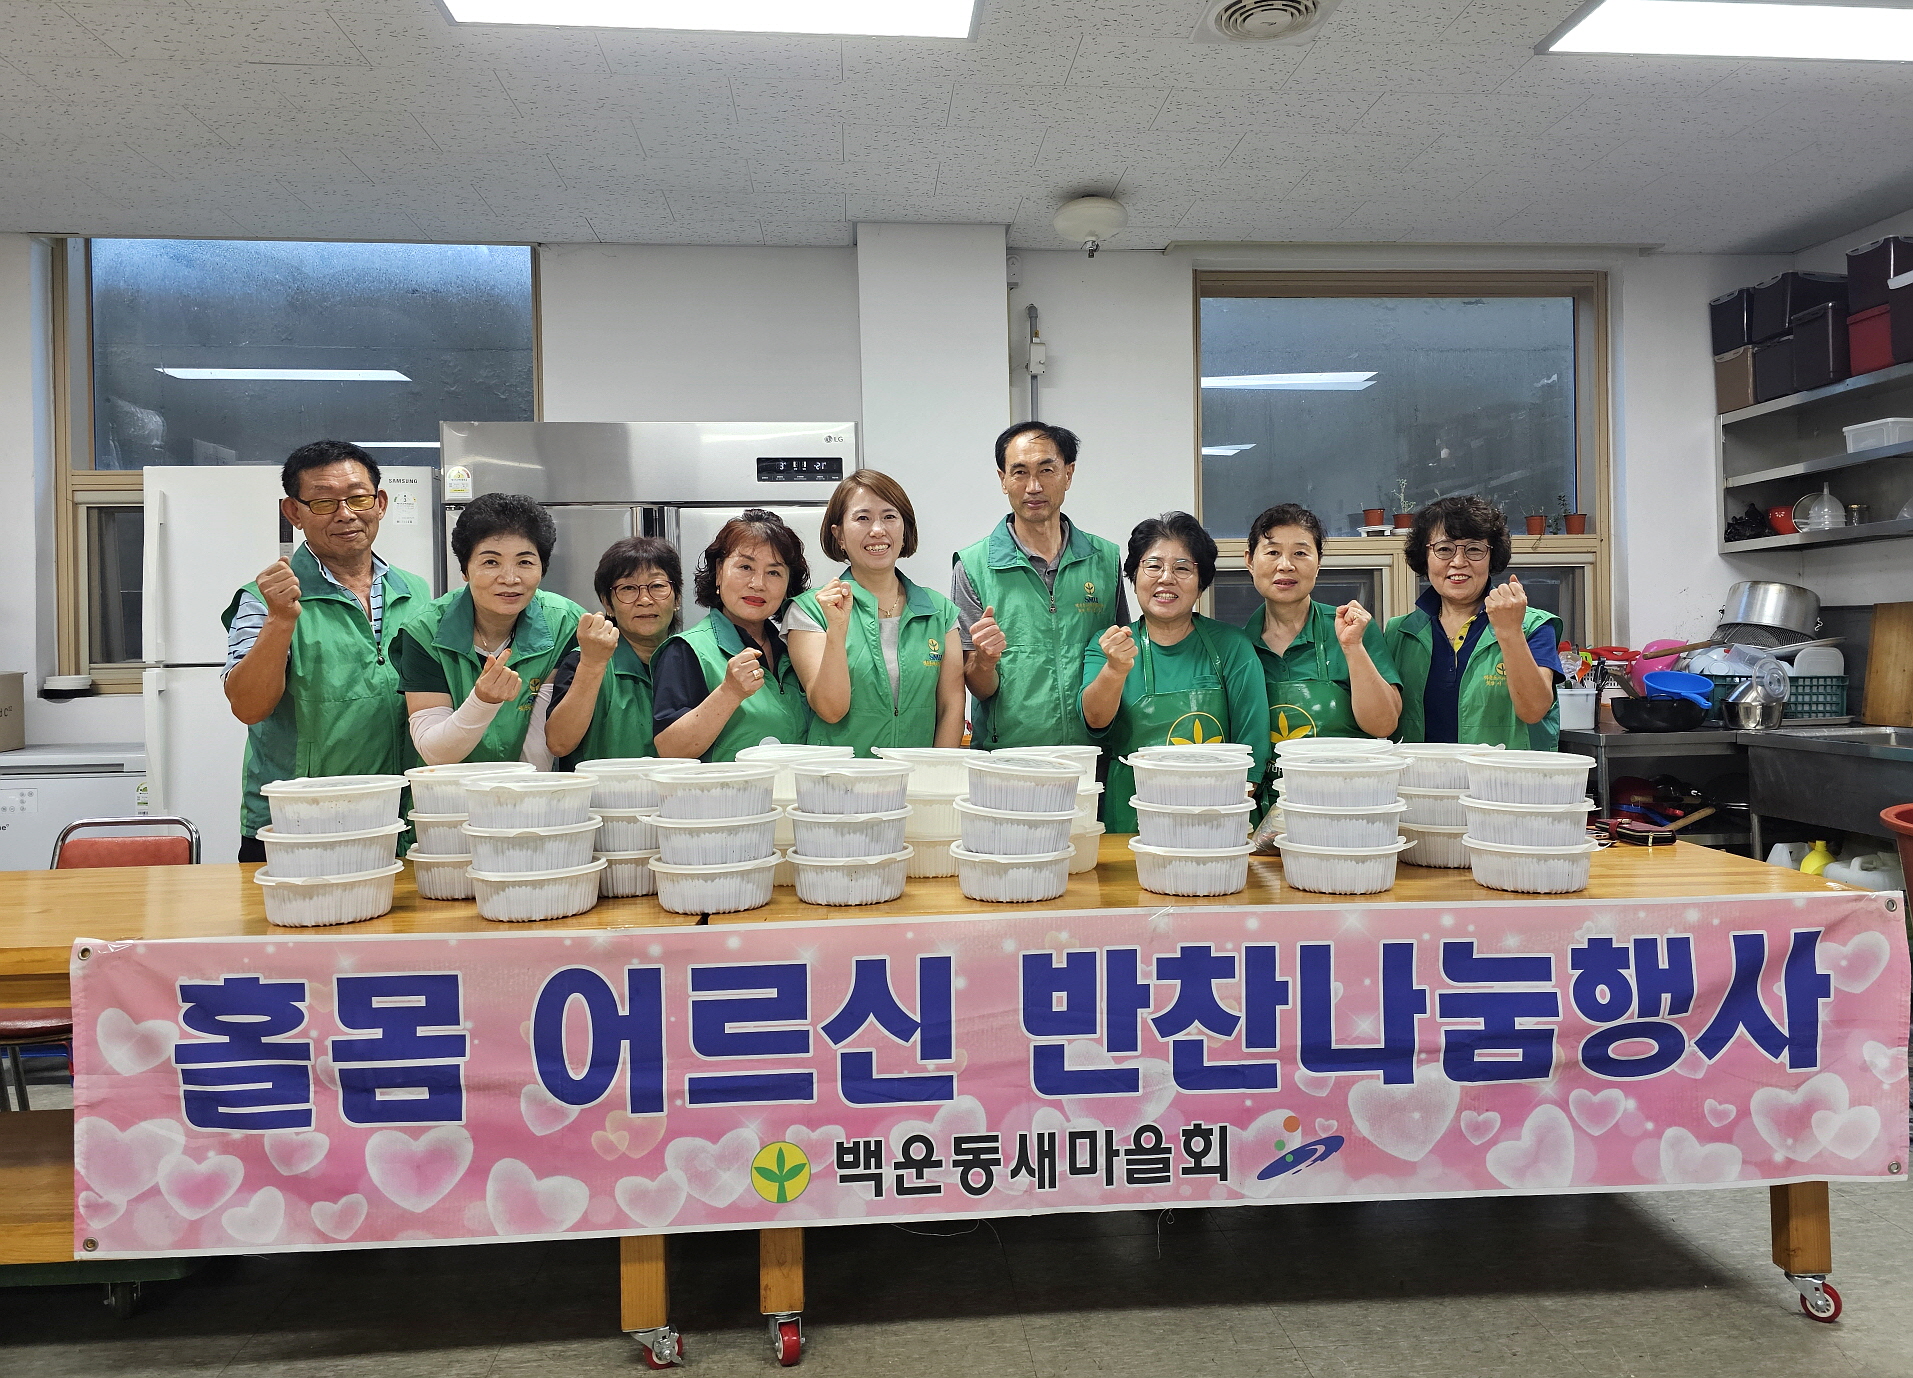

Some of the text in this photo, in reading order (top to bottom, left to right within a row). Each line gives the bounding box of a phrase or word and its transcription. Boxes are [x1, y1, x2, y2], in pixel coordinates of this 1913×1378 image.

[174, 930, 1832, 1130] 홀몸 어르신 반찬나눔행사
[835, 1123, 1230, 1198] 백운동새마을회
